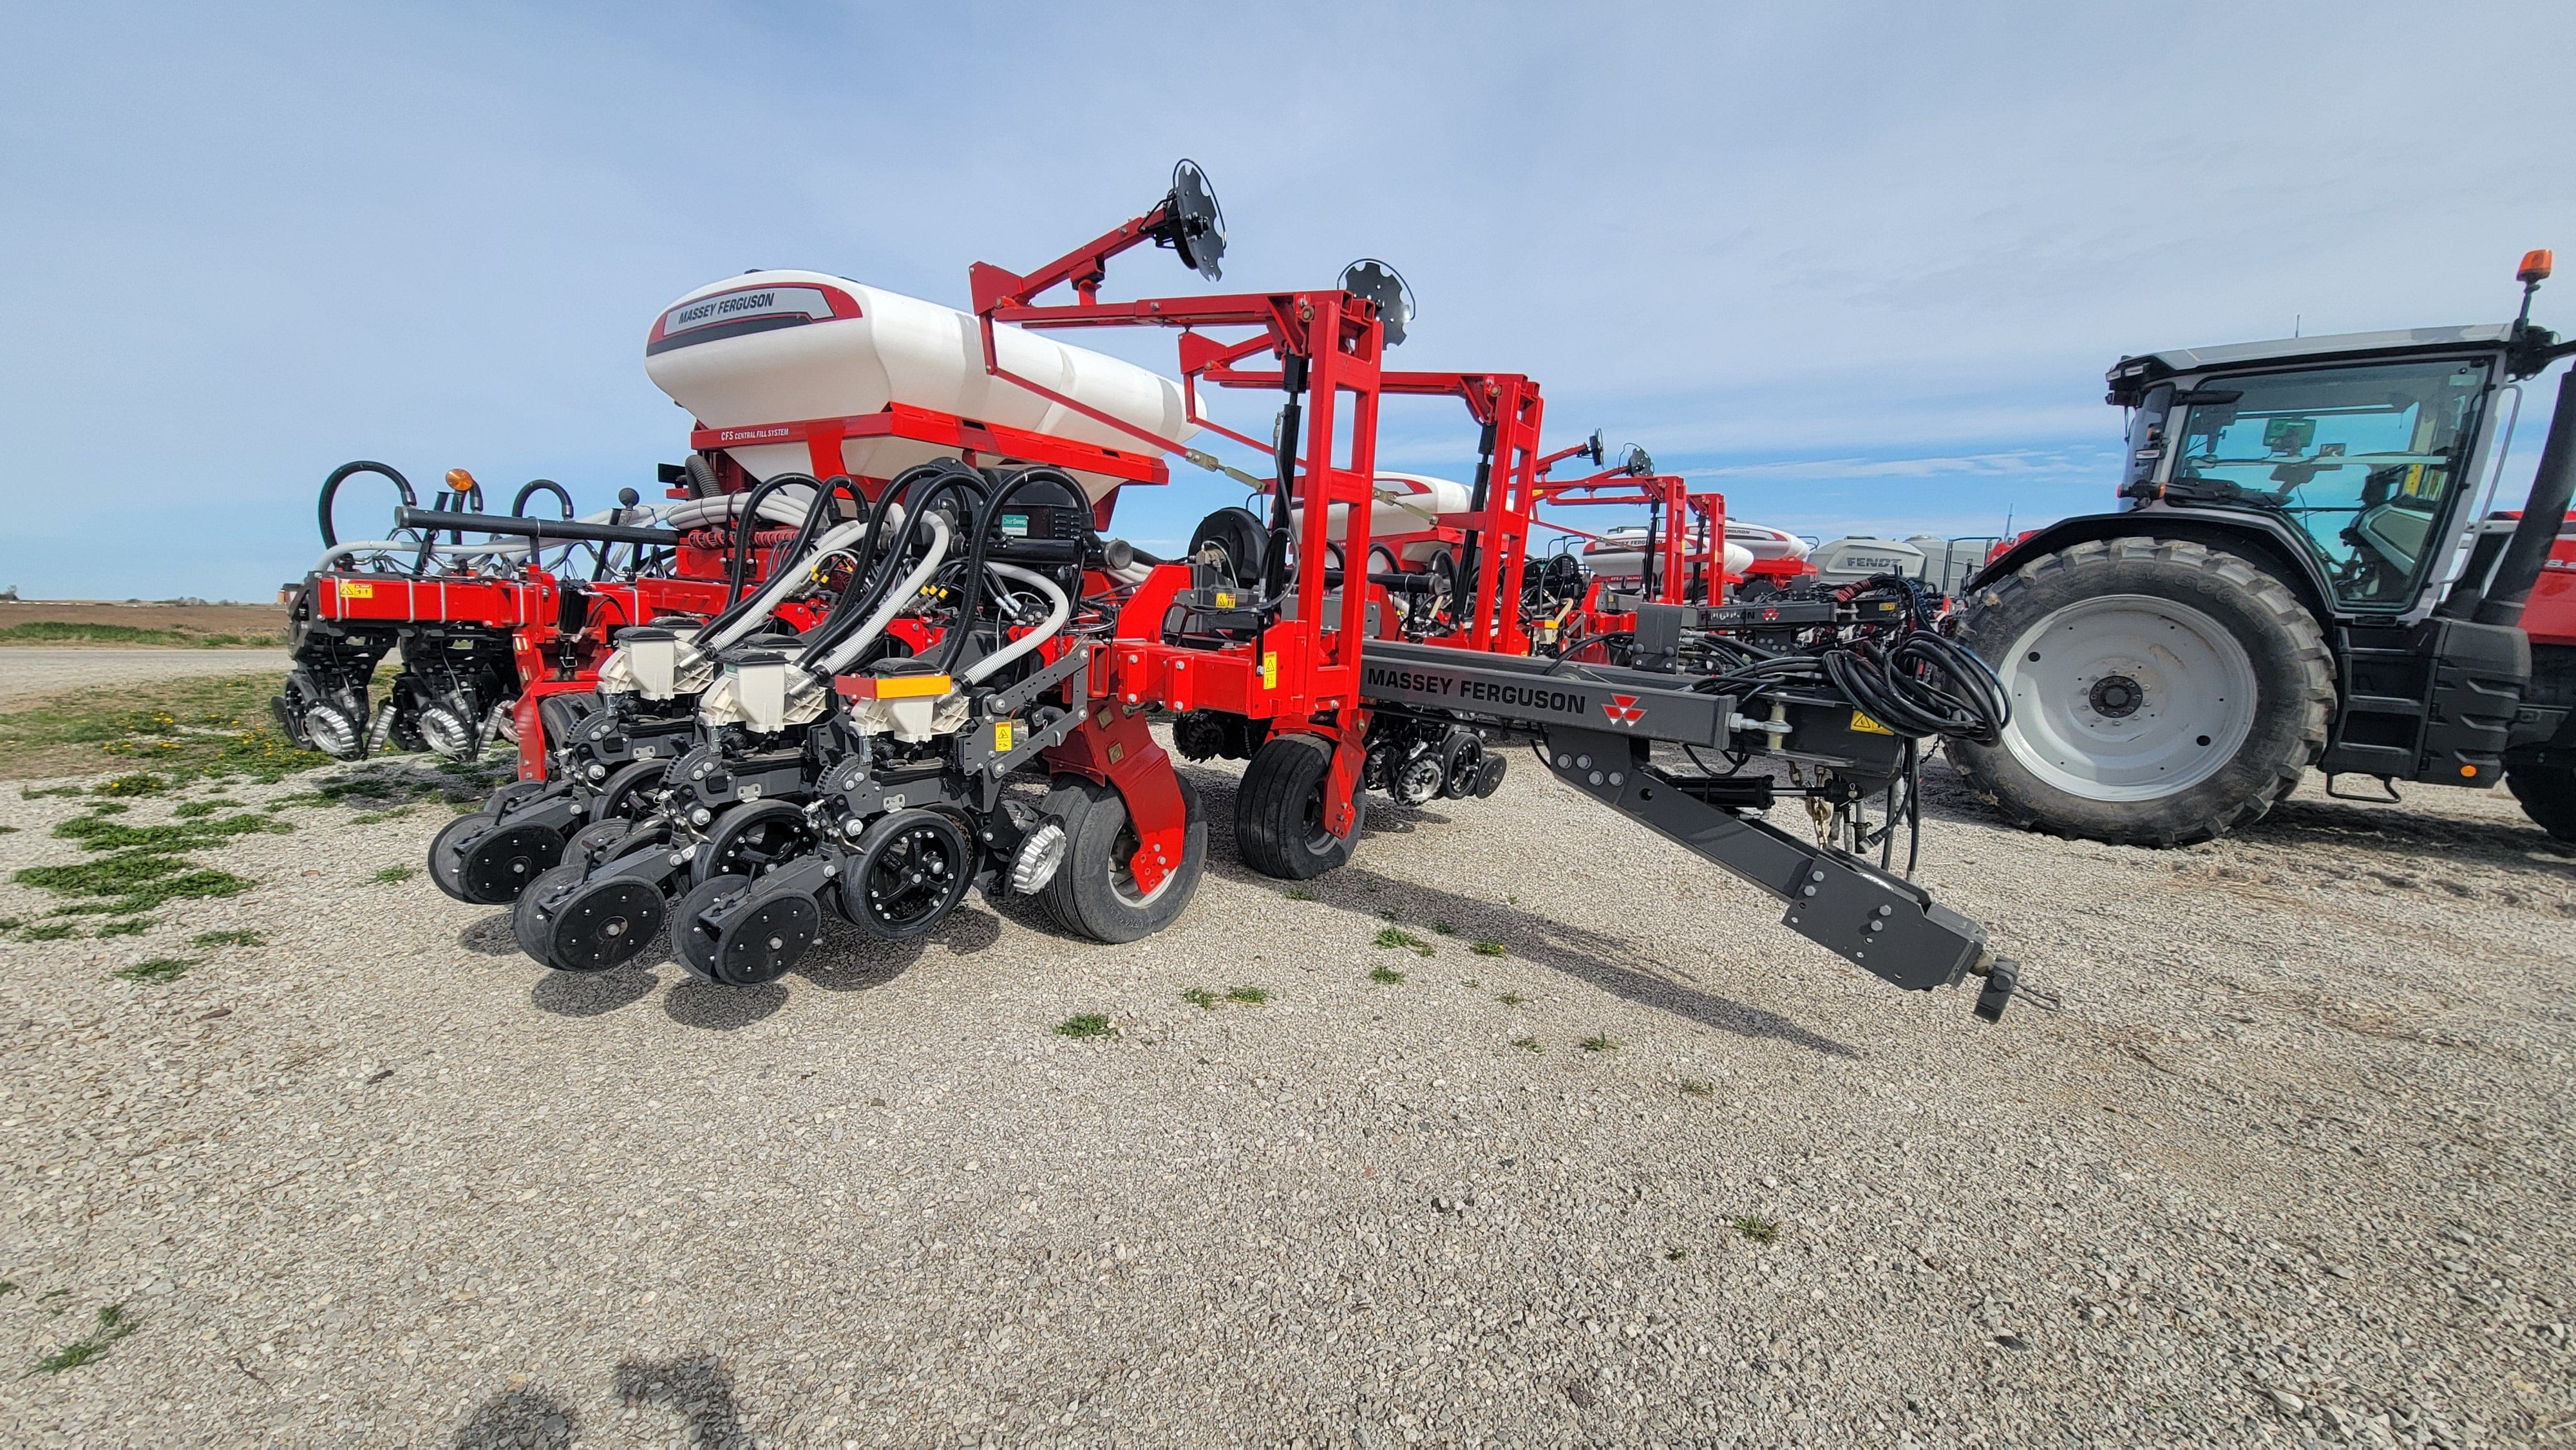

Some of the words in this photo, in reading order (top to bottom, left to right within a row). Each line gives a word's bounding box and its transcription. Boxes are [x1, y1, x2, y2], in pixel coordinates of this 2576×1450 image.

[678, 303, 717, 325] MASSEY
[717, 292, 775, 315] FERGUSON
[721, 431, 734, 441] CFS
[734, 431, 756, 440] CENTRAL
[756, 430, 767, 438] FILL
[767, 428, 789, 437] SYSTEM
[1846, 557, 1902, 567] FENDT
[1367, 668, 1453, 695] MASSEY
[1460, 680, 1586, 715] FERGUSON
